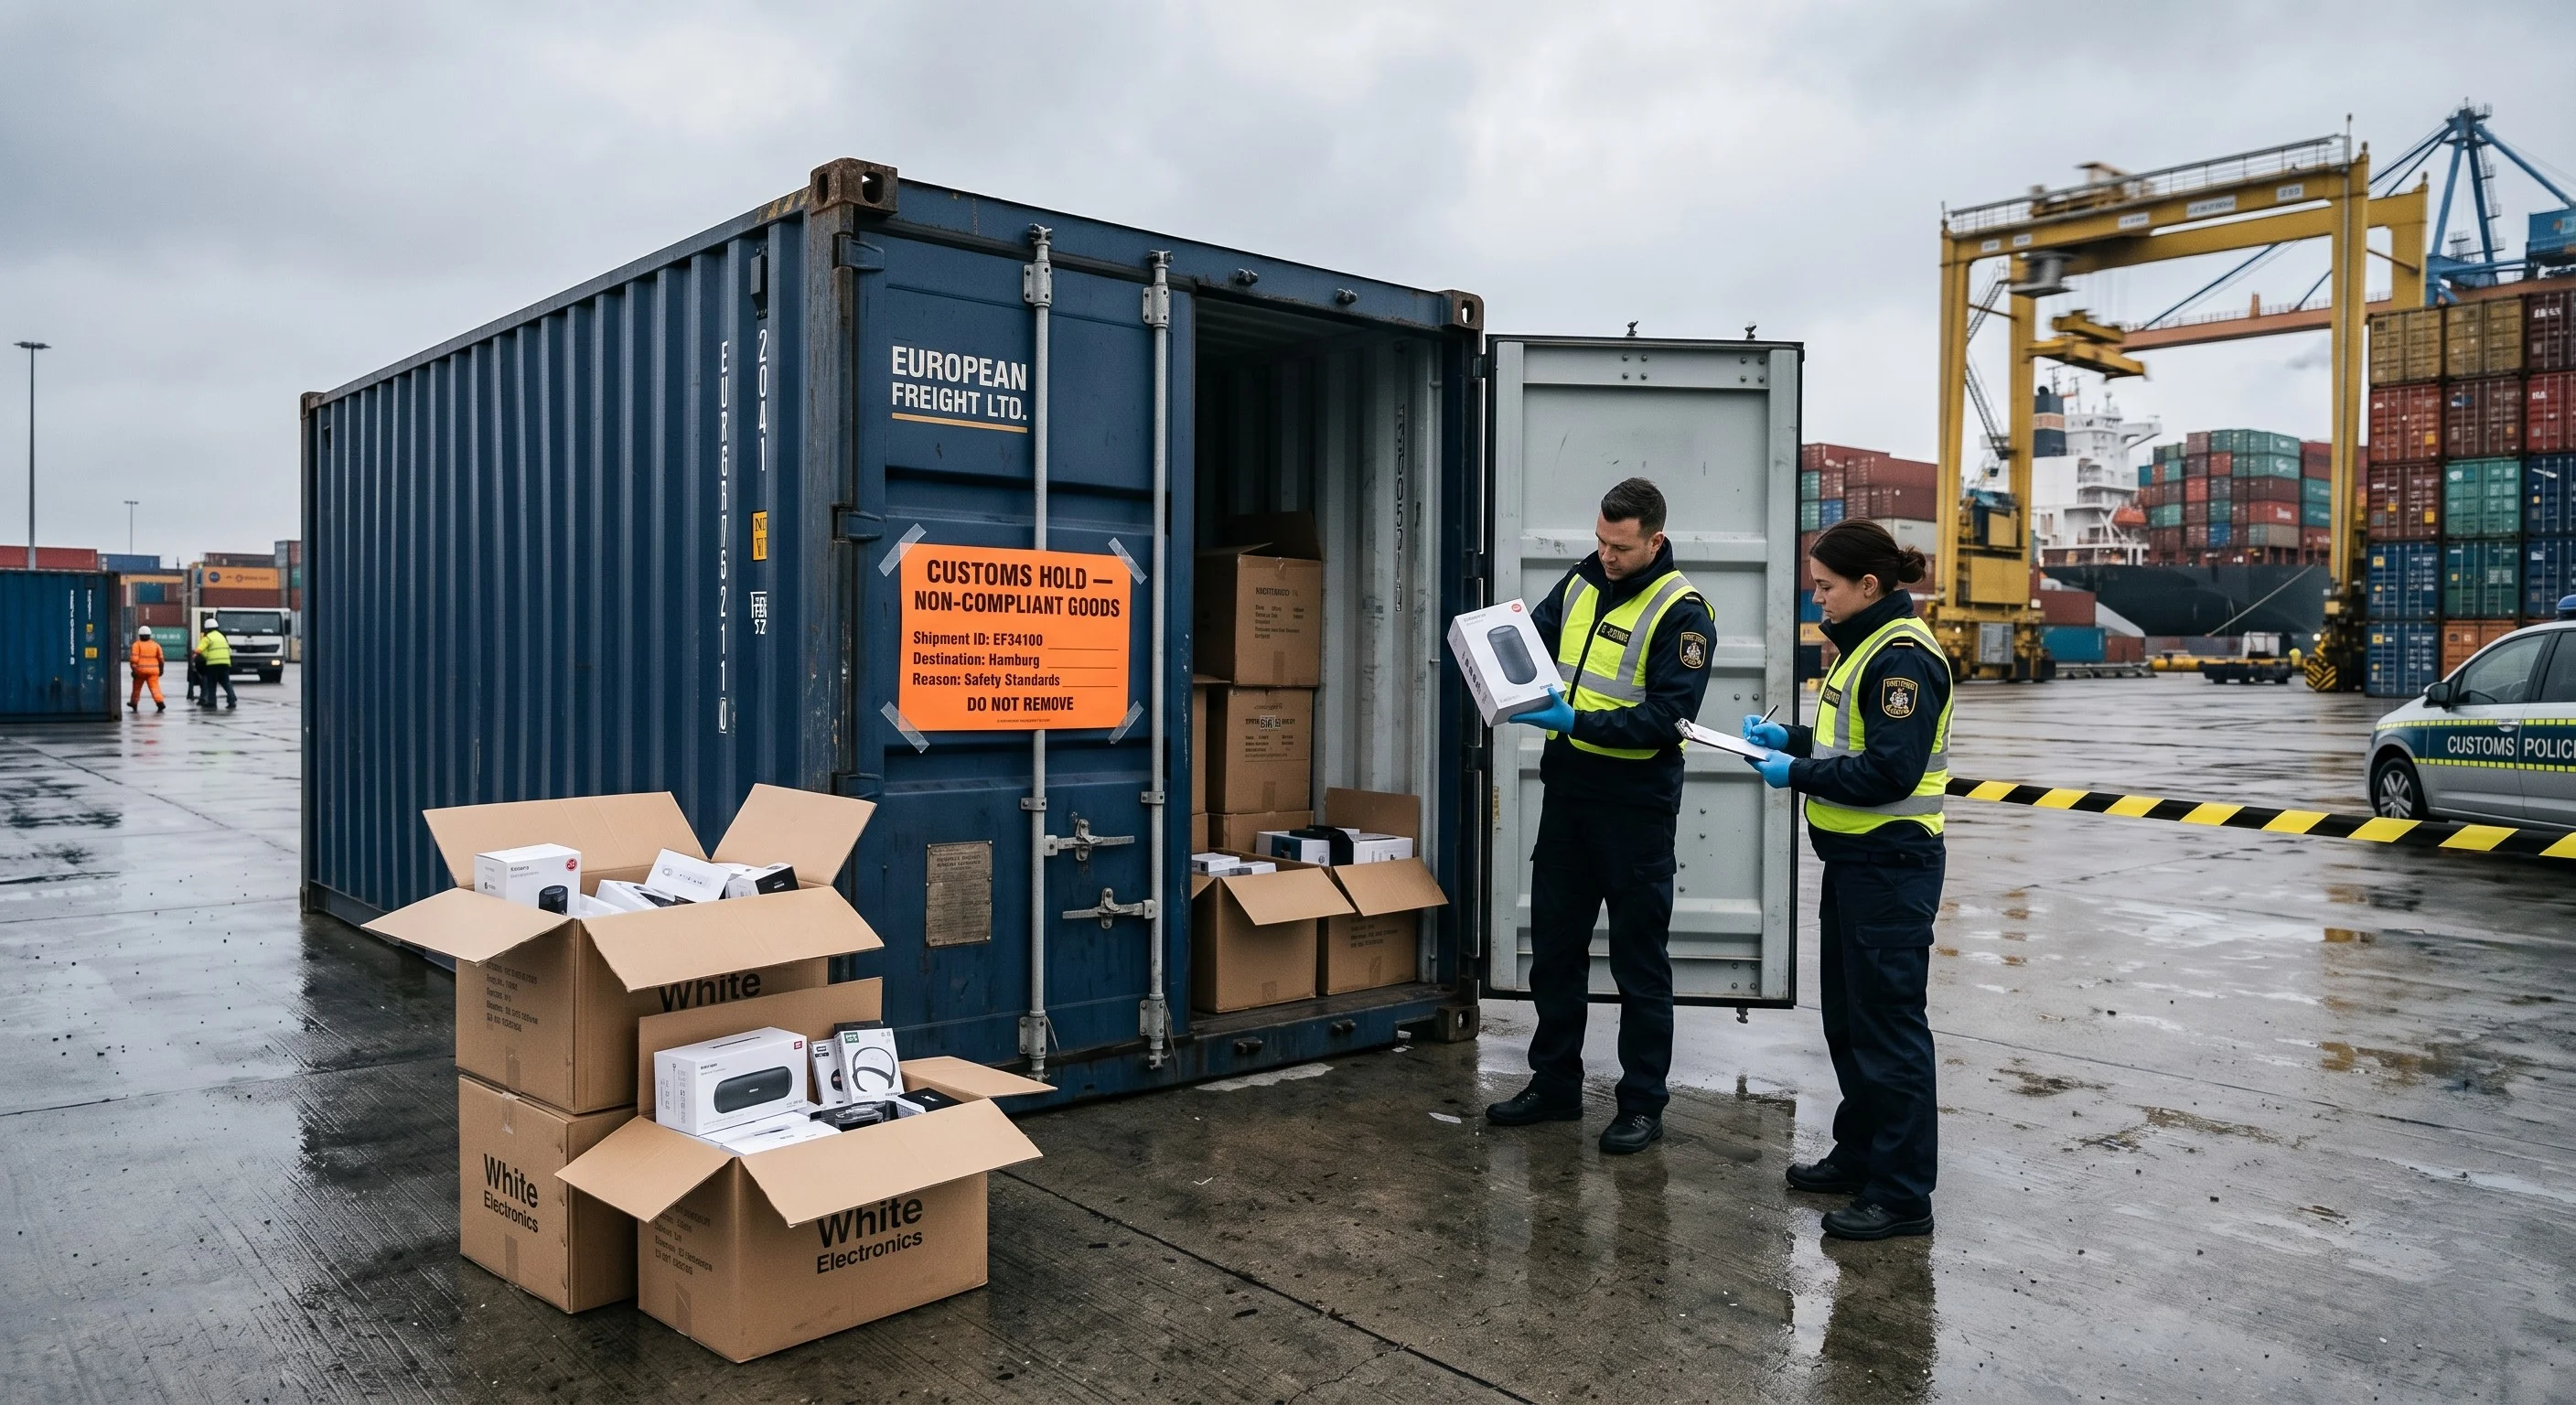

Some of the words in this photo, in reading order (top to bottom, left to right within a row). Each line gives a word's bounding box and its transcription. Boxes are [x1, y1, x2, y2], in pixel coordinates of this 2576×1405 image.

[892, 345, 1026, 391] EUROPEAN
[758, 329, 767, 471] 2041
[892, 381, 981, 414] FREIGHT
[987, 393, 1027, 421] LTD.
[927, 559, 1033, 587] CUSTOMS
[1039, 565, 1087, 590] HOLD
[914, 590, 1064, 616] NON-COMPLIANT
[1068, 596, 1121, 617] GOODS
[913, 631, 971, 648] Shipment
[973, 632, 990, 646] ID:
[993, 633, 1044, 646] EF34100
[913, 652, 985, 666] Destination:
[989, 653, 1040, 669] Hamburg
[913, 672, 961, 686] Reason:
[964, 673, 1002, 689] Safety
[1004, 673, 1060, 686] Standards
[967, 697, 987, 712] DO
[991, 697, 1020, 712] NOT
[1023, 696, 1074, 711] REMOVE
[2447, 735, 2515, 756] CUSTOMS
[2524, 737, 2576, 759] POLIC
[659, 972, 761, 1013] White
[484, 1153, 538, 1208] White
[484, 1190, 539, 1233] Electronics
[817, 1197, 923, 1249] White
[817, 1231, 923, 1274] Electronics
